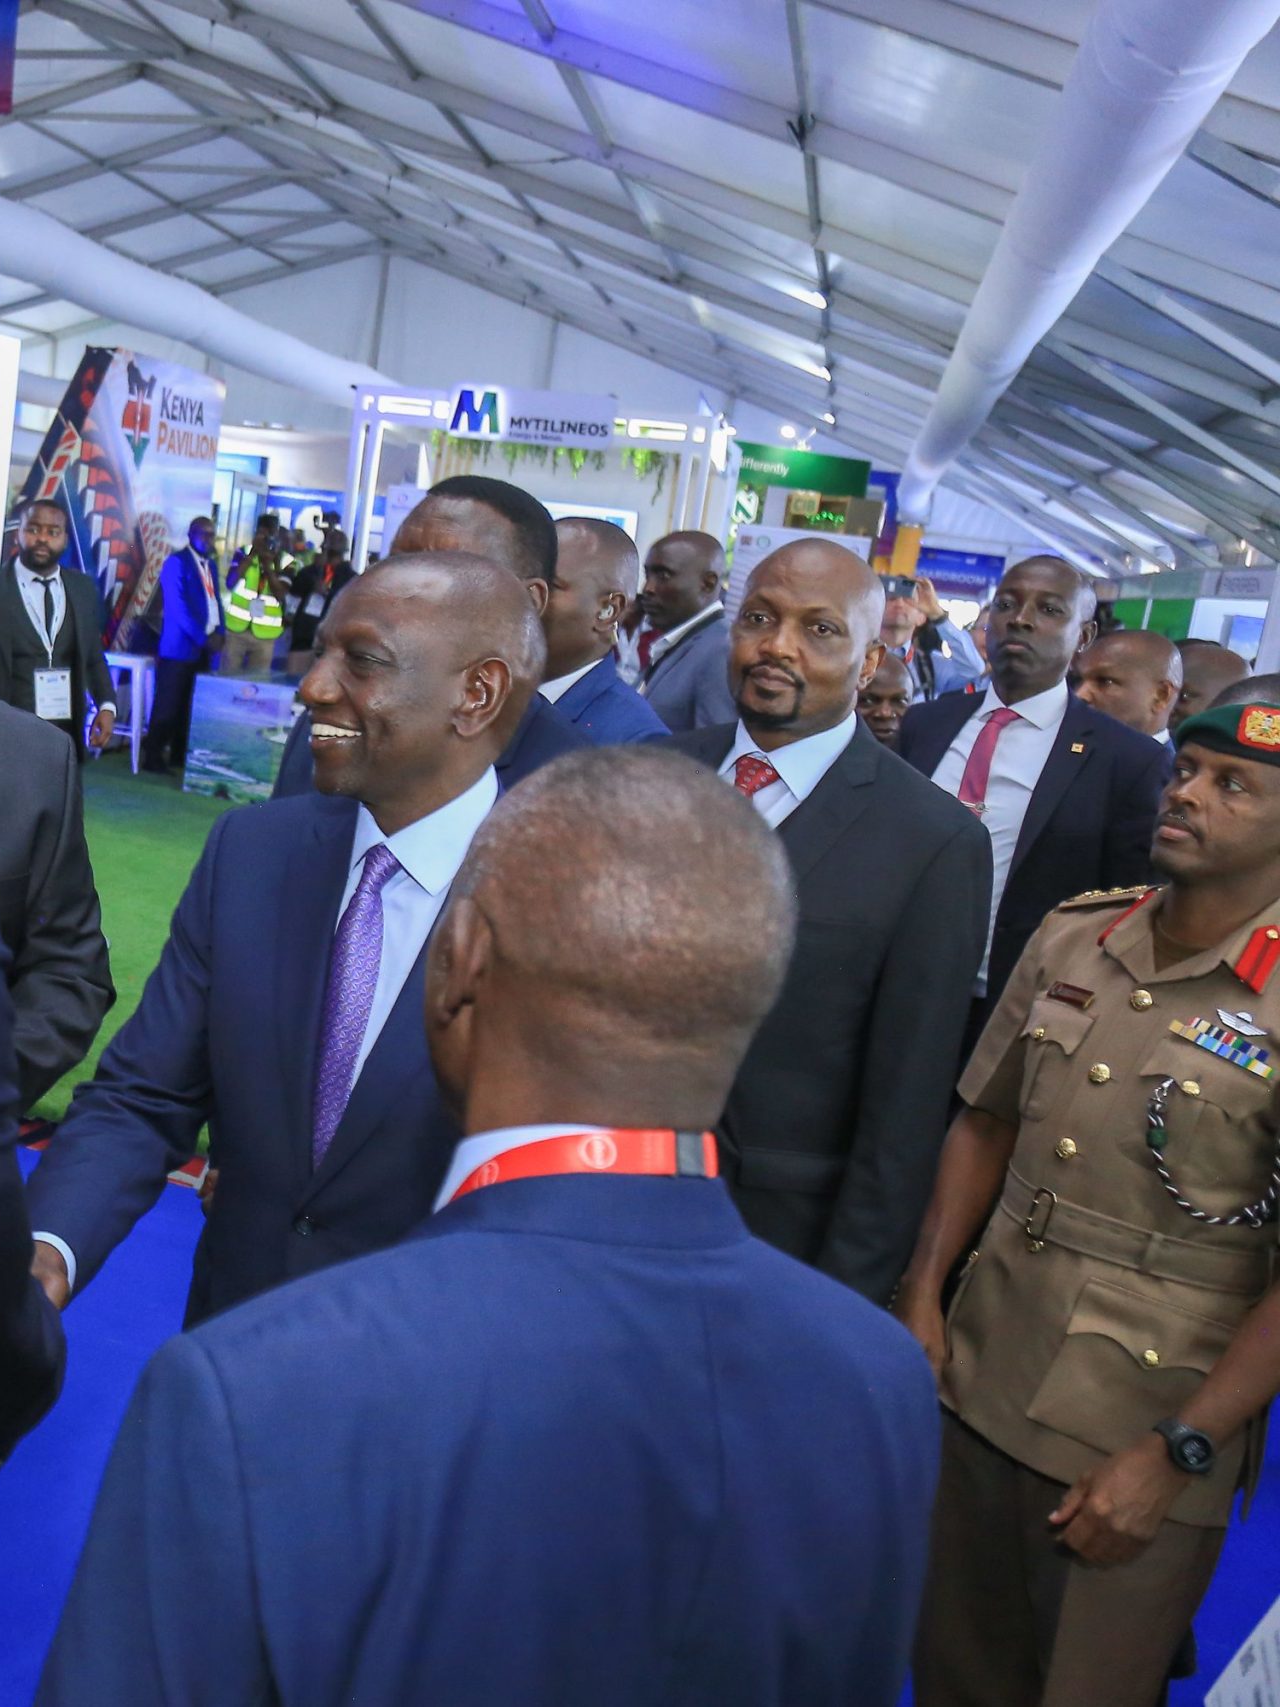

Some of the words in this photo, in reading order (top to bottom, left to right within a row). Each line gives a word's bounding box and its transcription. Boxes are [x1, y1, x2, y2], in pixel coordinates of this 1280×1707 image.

[160, 386, 204, 427] KENYA
[157, 421, 218, 461] PAVILION
[510, 416, 609, 438] MYTILINEOS
